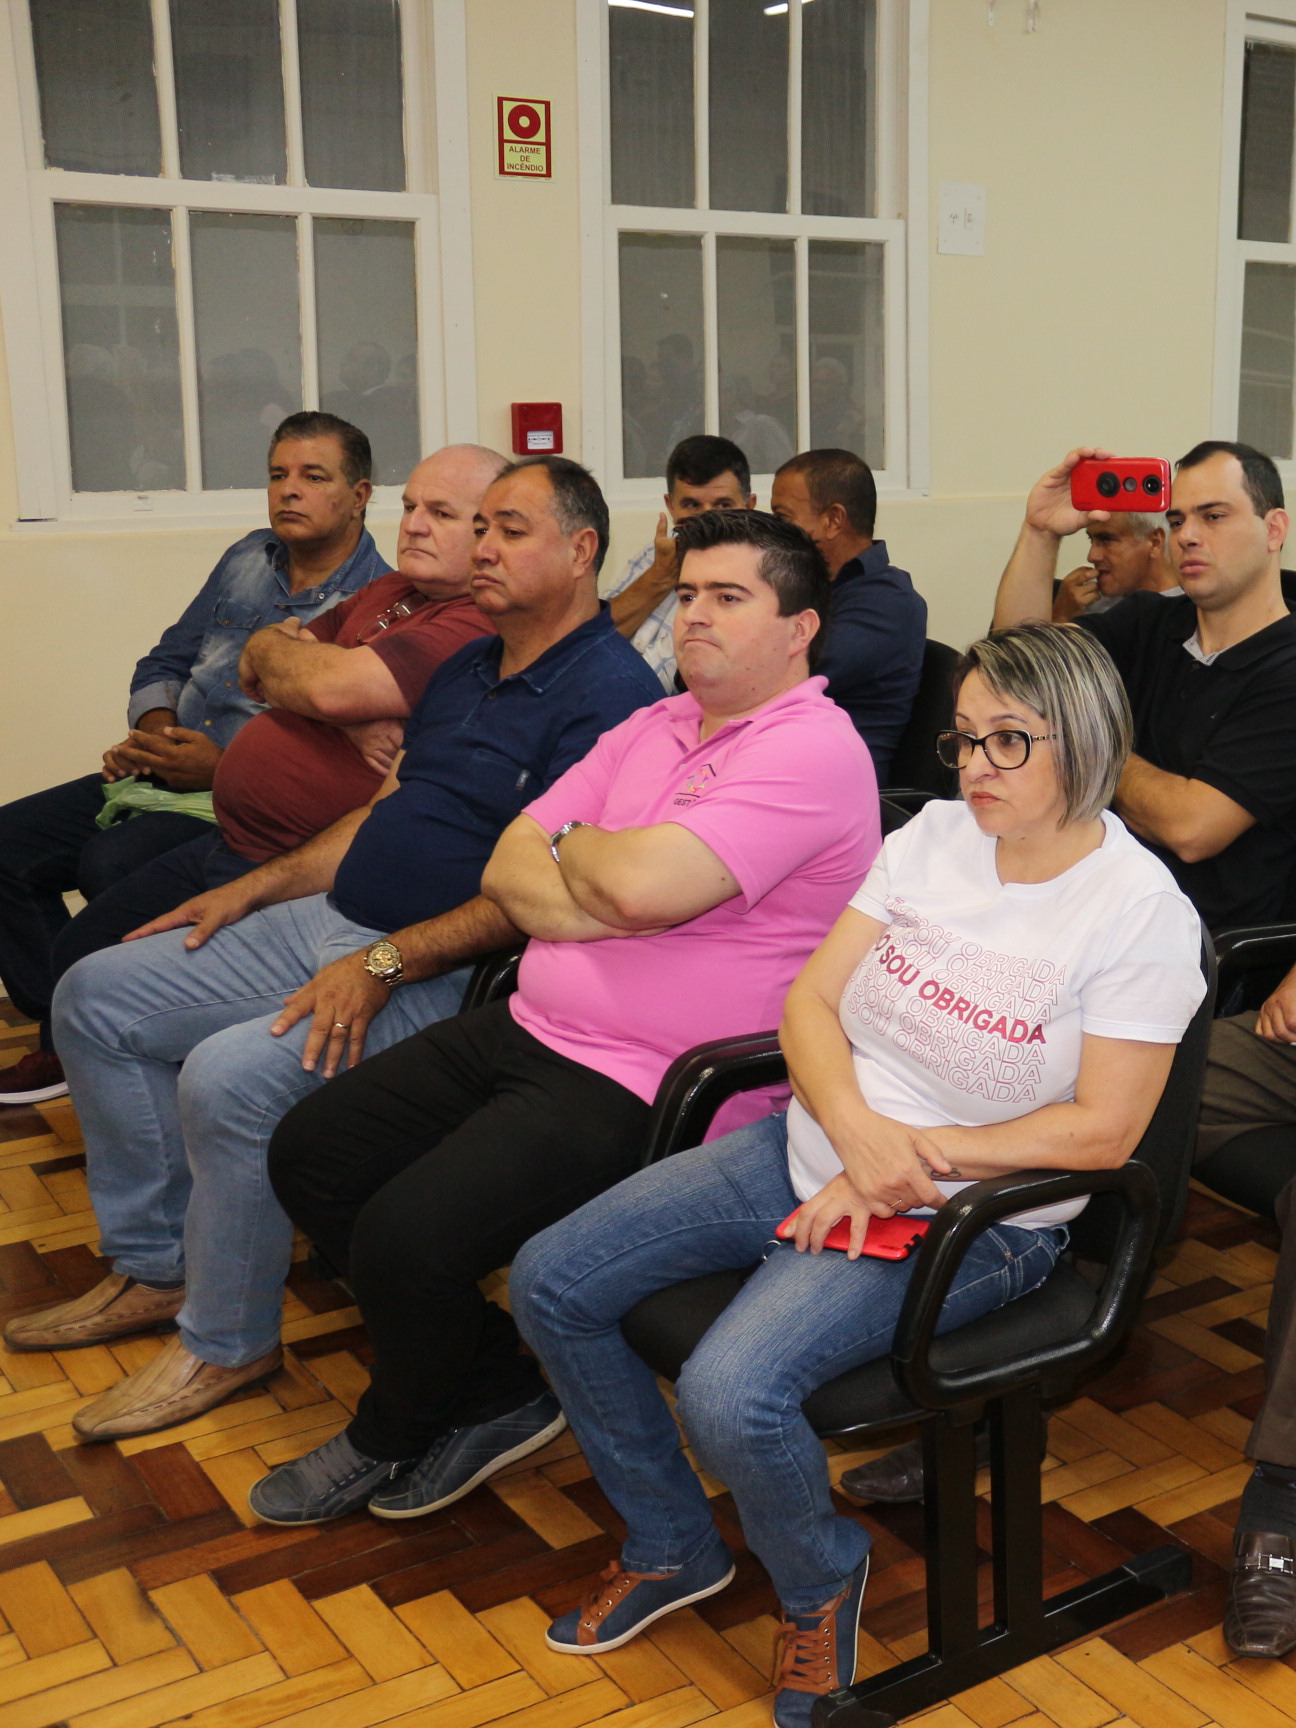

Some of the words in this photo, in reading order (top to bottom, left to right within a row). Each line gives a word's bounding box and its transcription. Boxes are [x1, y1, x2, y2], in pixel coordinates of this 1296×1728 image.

[509, 146, 541, 155] ALARME
[879, 945, 921, 986] SOU
[918, 980, 1047, 1045] OBRIGADA
[932, 968, 1052, 1024] OBRIGADA
[947, 954, 1059, 1006] OBRIGADA
[961, 941, 1067, 986] OBRIGADA
[847, 991, 890, 1037] SOU
[892, 1029, 1037, 1103] OBRIGADA
[855, 976, 895, 1018] SOU
[899, 1012, 1042, 1085] OBRIGADA
[866, 960, 907, 1003] SOU
[906, 995, 1046, 1065] OBRIGADA
